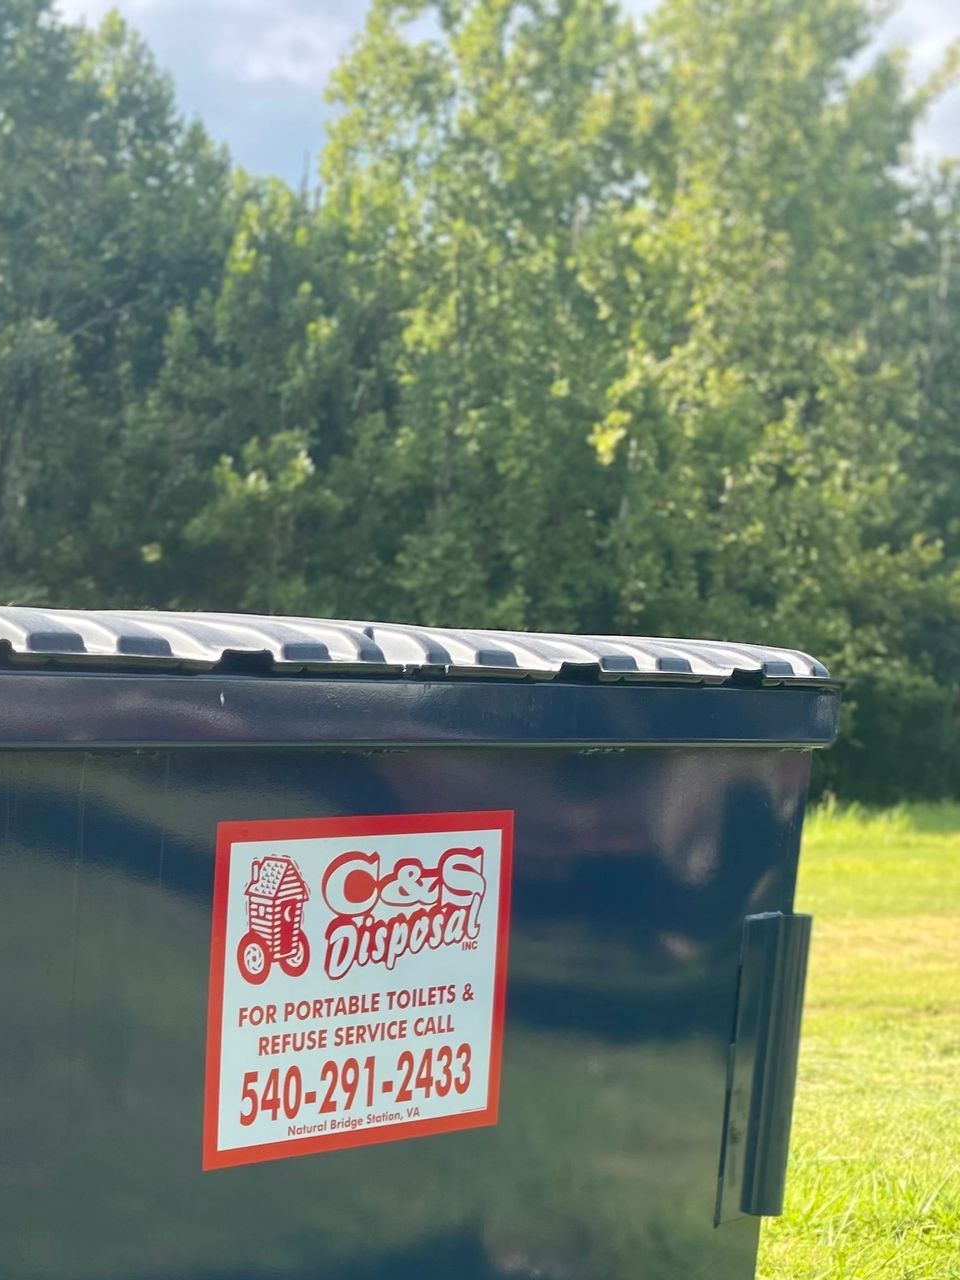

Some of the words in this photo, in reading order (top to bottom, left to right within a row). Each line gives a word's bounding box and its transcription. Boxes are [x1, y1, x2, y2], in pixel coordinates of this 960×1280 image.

[321, 846, 487, 916] C&S
[324, 893, 482, 980] Disposal
[461, 940, 478, 951] INC
[238, 1005, 277, 1028] FOR
[284, 993, 380, 1023] PORTABLE
[387, 984, 456, 1010] TOILETS
[462, 983, 474, 1001] &
[258, 1028, 327, 1056] REFUSE
[334, 1020, 407, 1048] SERVICE
[413, 1014, 455, 1036] CALL
[240, 1043, 472, 1126] 540-291-2433
[287, 1121, 327, 1137] Natural
[330, 1116, 363, 1131] Bridge
[366, 1110, 404, 1125] Station,
[406, 1107, 421, 1119] VA
